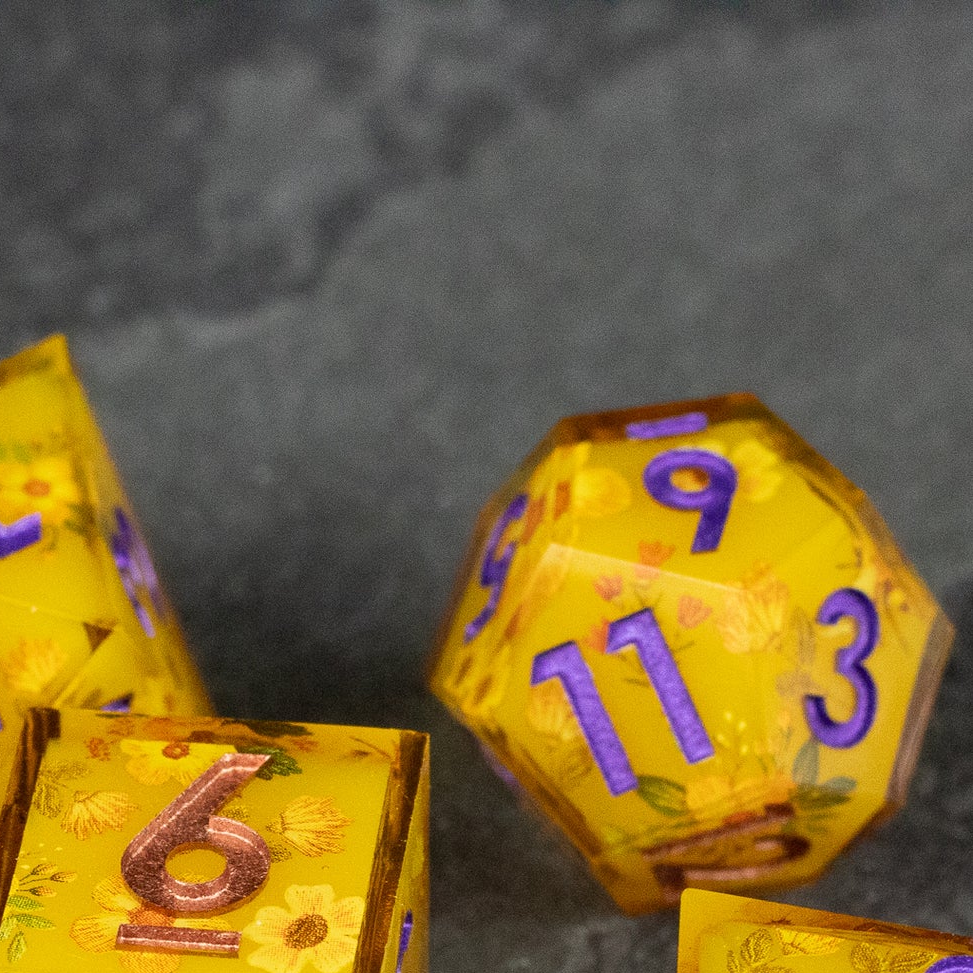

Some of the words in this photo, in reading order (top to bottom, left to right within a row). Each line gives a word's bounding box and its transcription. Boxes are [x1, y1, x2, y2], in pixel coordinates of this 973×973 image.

[530, 608, 715, 797] 11
[805, 588, 880, 749] 3
[121, 752, 271, 913] 6
